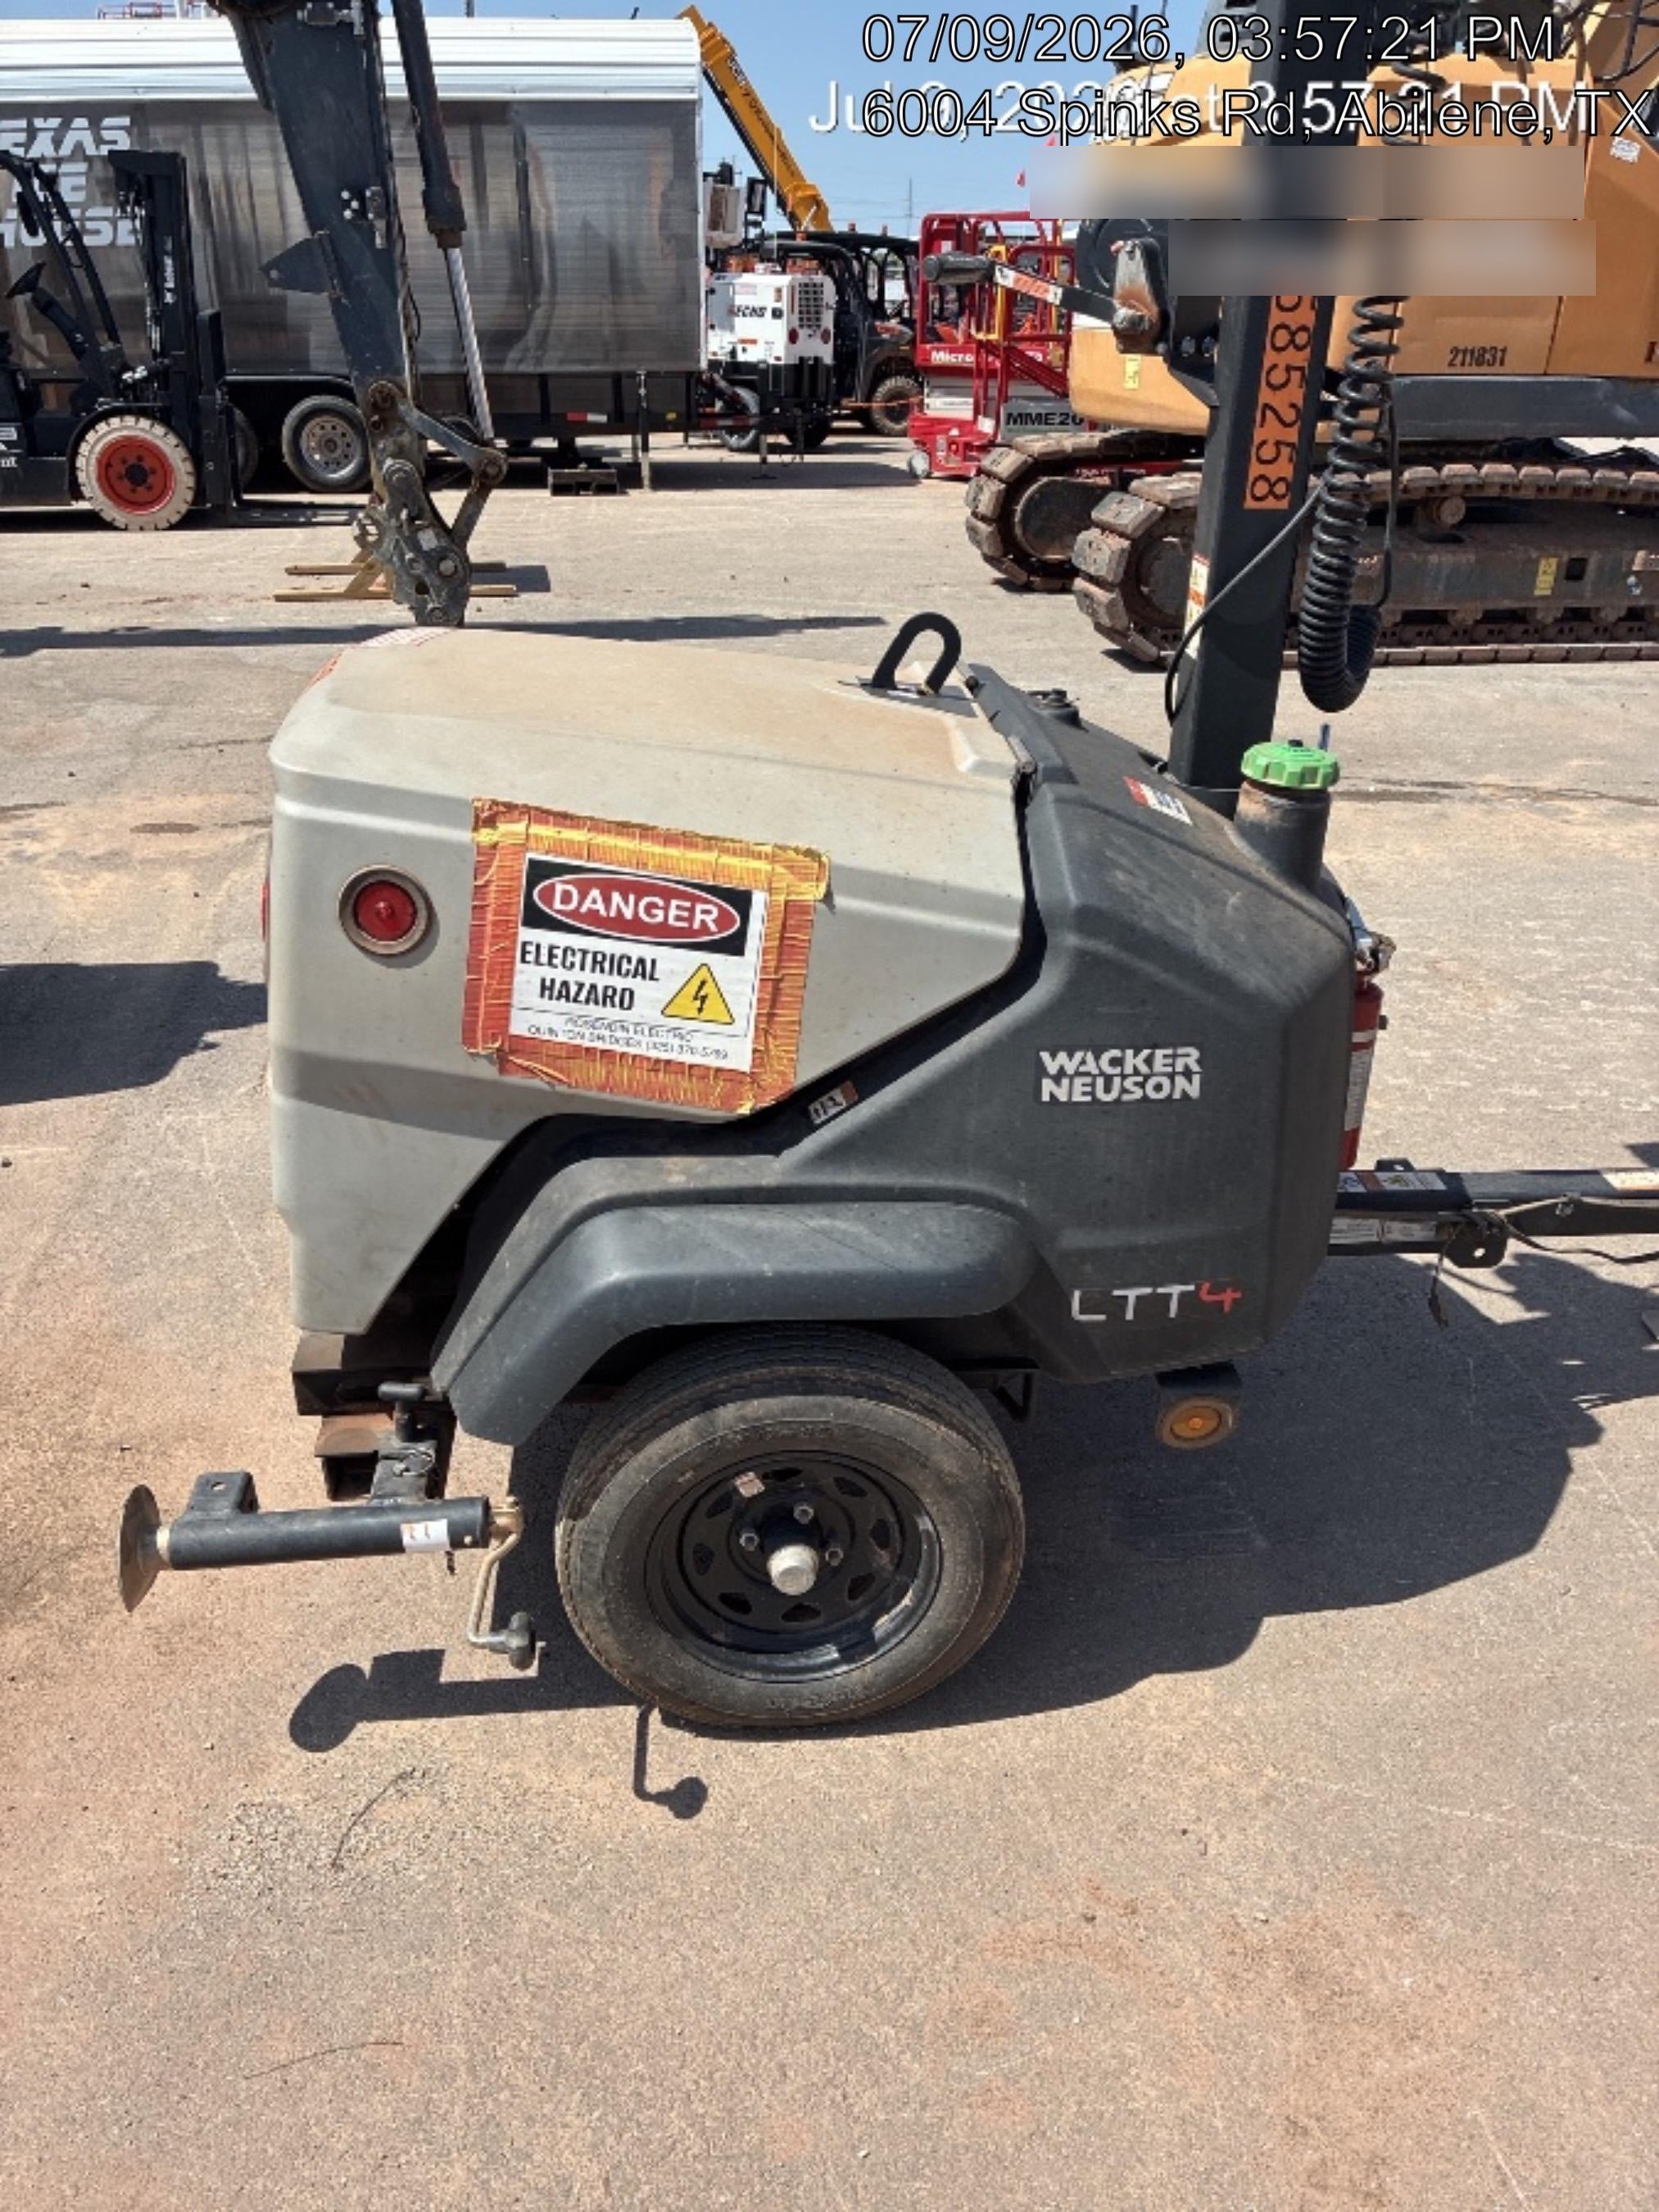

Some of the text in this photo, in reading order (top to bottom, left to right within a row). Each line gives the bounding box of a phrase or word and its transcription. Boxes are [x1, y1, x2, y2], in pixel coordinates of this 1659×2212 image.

[1447, 346, 1507, 367] 211831
[551, 882, 719, 932] DANGER
[519, 940, 660, 982] ELECTRICAL
[539, 977, 636, 1012] HAZARD
[1039, 1046, 1203, 1076] WACKER
[1040, 1074, 1201, 1102] NEUSON
